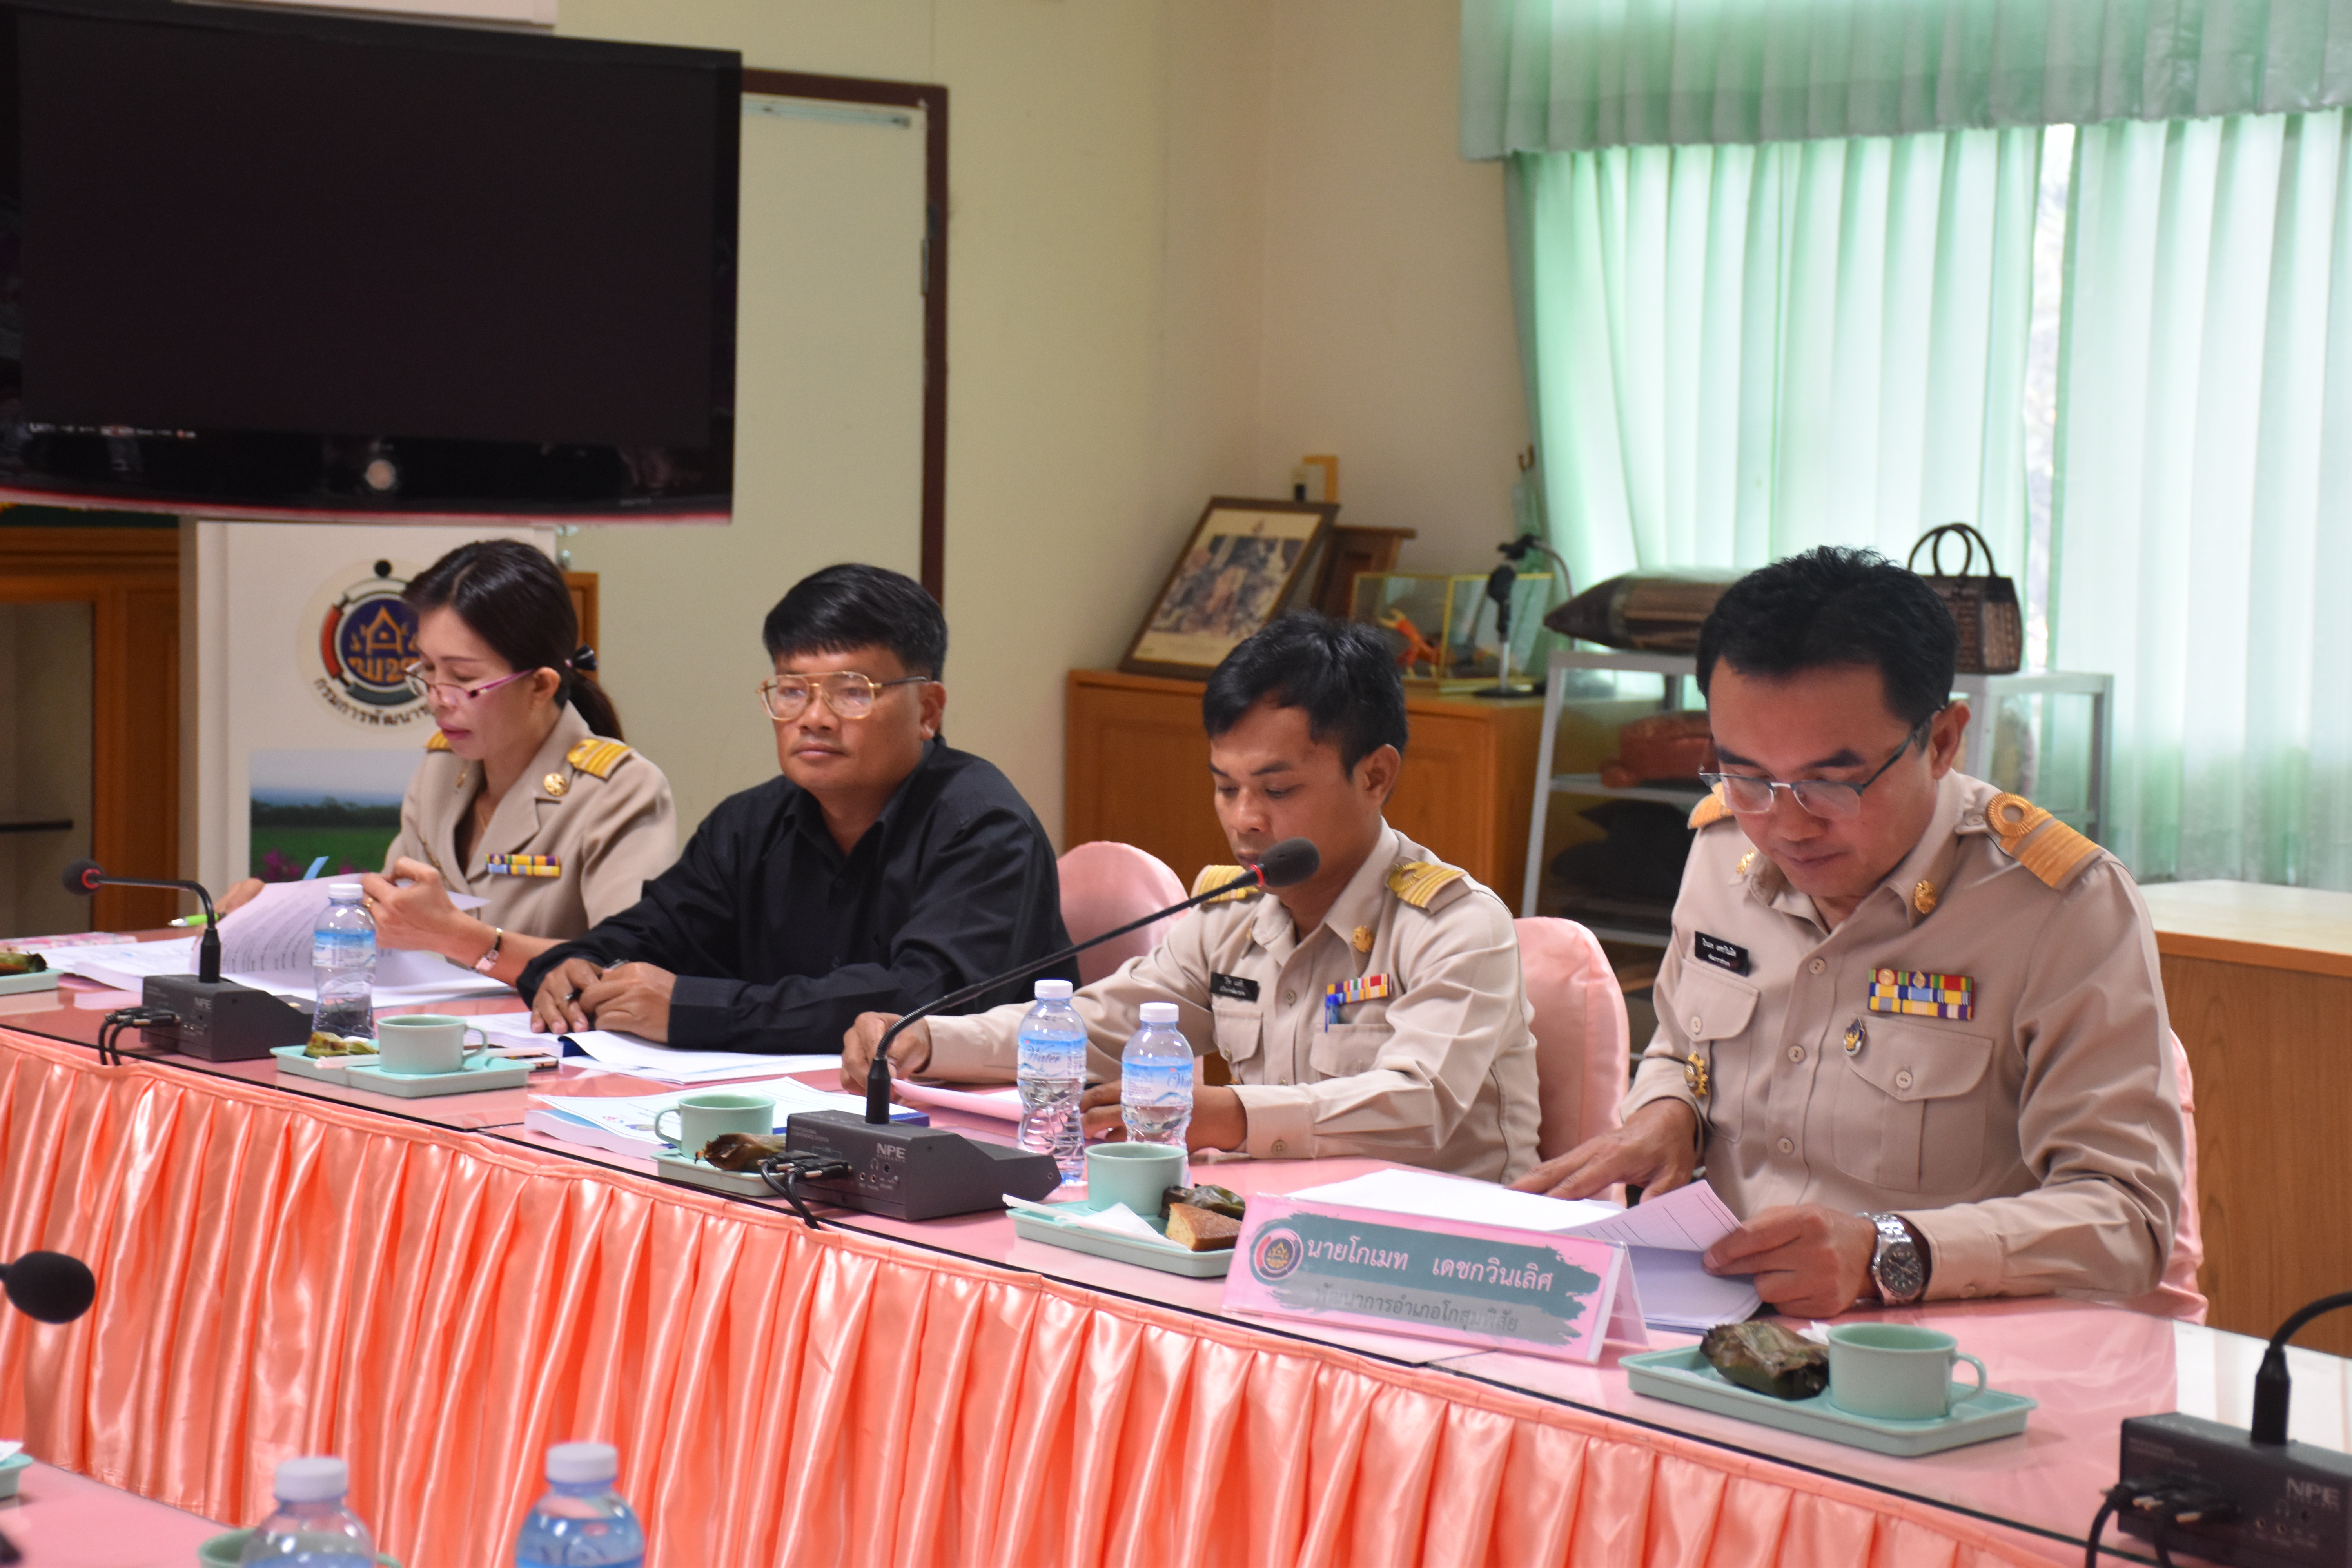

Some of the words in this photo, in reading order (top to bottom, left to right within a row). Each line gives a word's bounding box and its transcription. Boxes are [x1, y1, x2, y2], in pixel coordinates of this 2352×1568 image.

[876, 1142, 906, 1159] NPE
[1308, 1235, 1409, 1270] นายโกเมท
[1432, 1257, 1553, 1292] เดชกวินเลิศ
[2287, 1477, 2341, 1507] NPE
